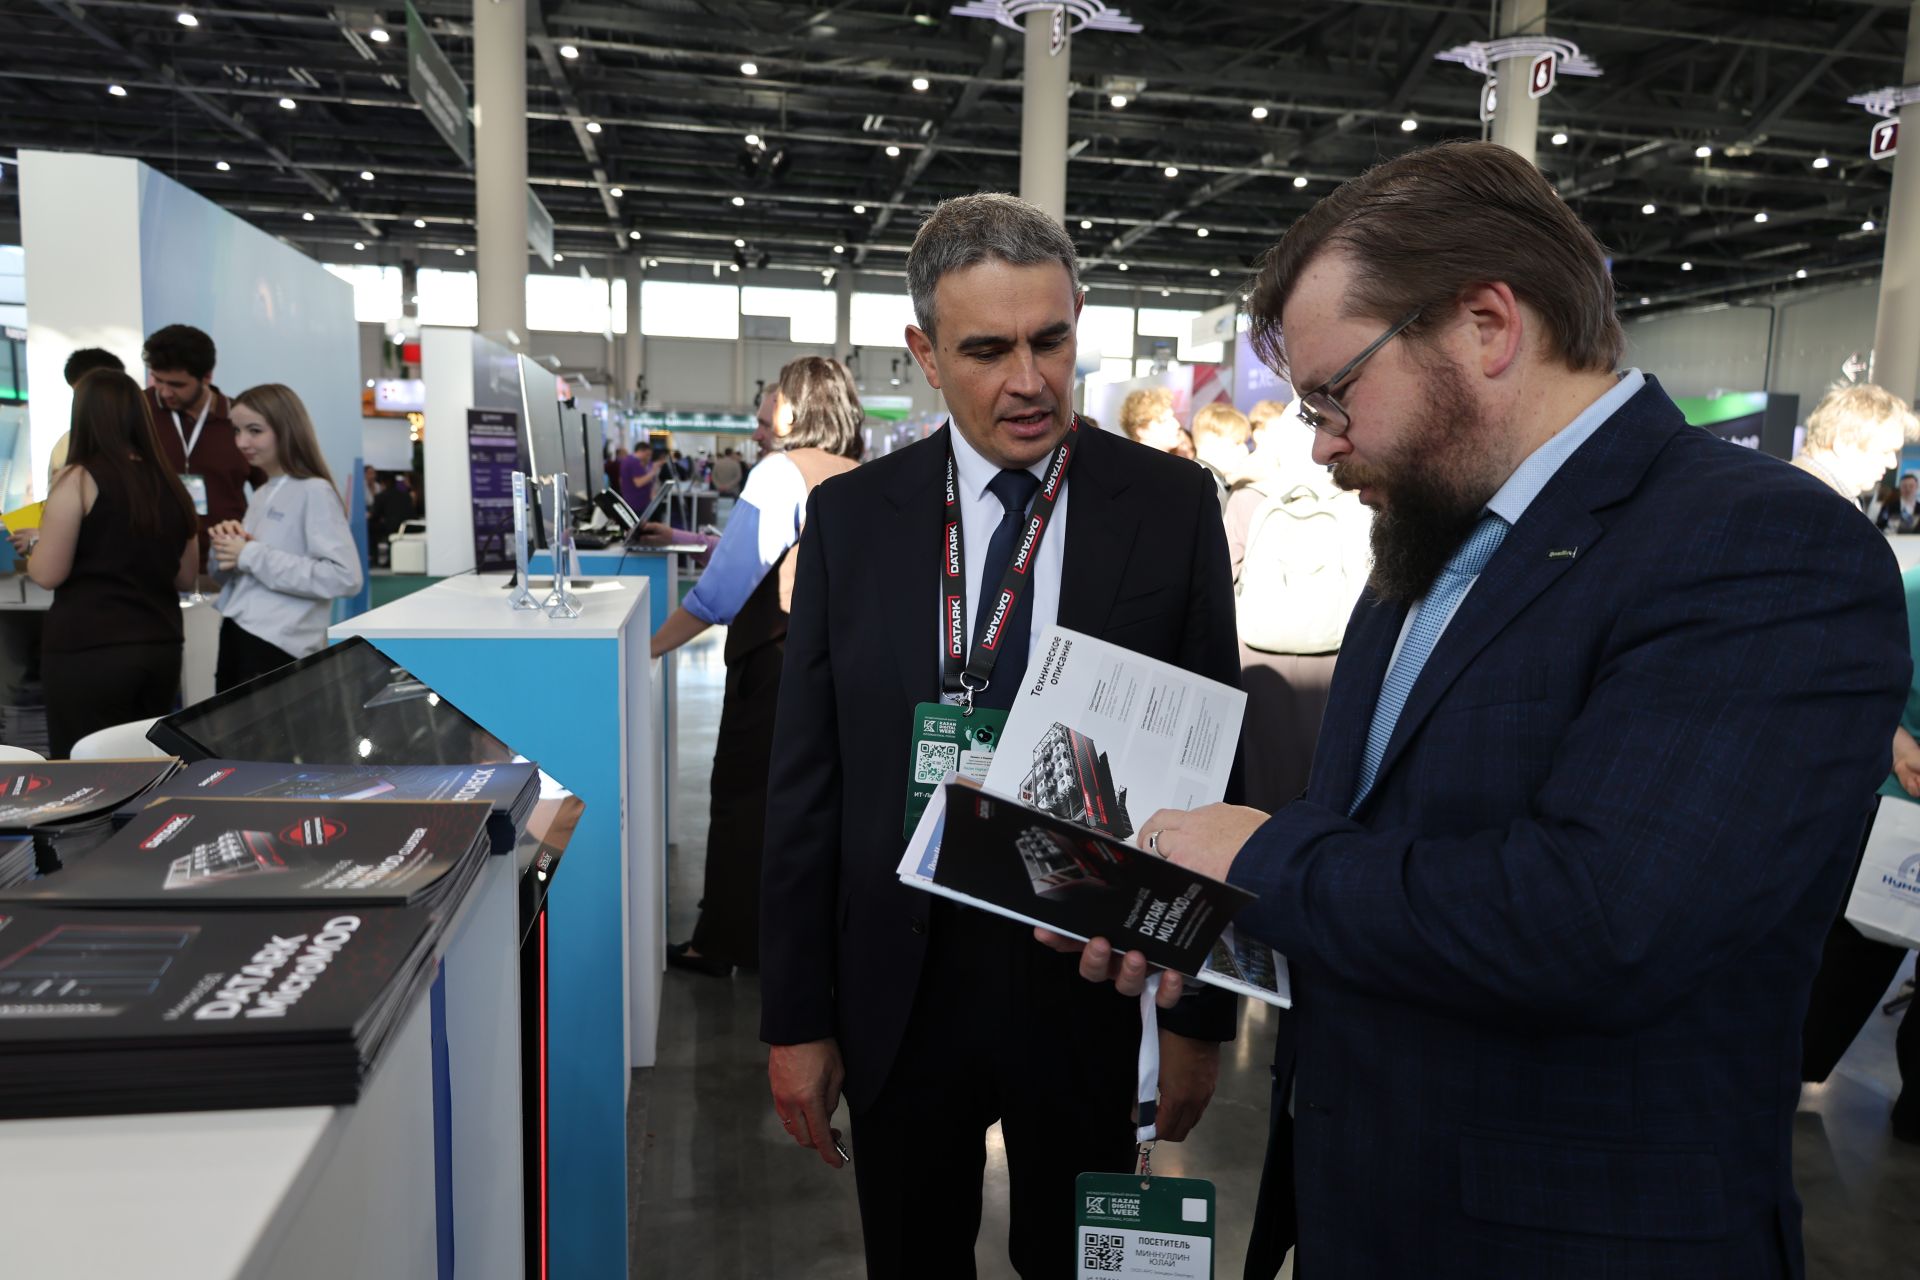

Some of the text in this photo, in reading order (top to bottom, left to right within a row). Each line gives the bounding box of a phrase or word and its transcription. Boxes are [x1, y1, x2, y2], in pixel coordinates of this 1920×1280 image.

[1536, 62, 1548, 88] 6
[1880, 126, 1894, 151] 7
[1044, 446, 1067, 496] DATARK
[949, 524, 959, 574] DATARK
[1014, 517, 1040, 569] DATARK
[951, 599, 961, 655] DATARK
[983, 592, 1011, 646] DATARK
[1030, 635, 1062, 696] Техническое
[1050, 639, 1073, 686] описание
[1139, 898, 1169, 937] DATARK
[1155, 896, 1191, 943] MULTIMOD
[194, 933, 309, 1020] DATARK
[245, 915, 361, 1018] MicroMOD
[1111, 1197, 1140, 1205] KAZAN
[1111, 1208, 1140, 1217] WEEK
[1135, 1249, 1190, 1261] МИННУЛЛИН
[1138, 1237, 1191, 1249] ПОСЕТИТЕЛЬ
